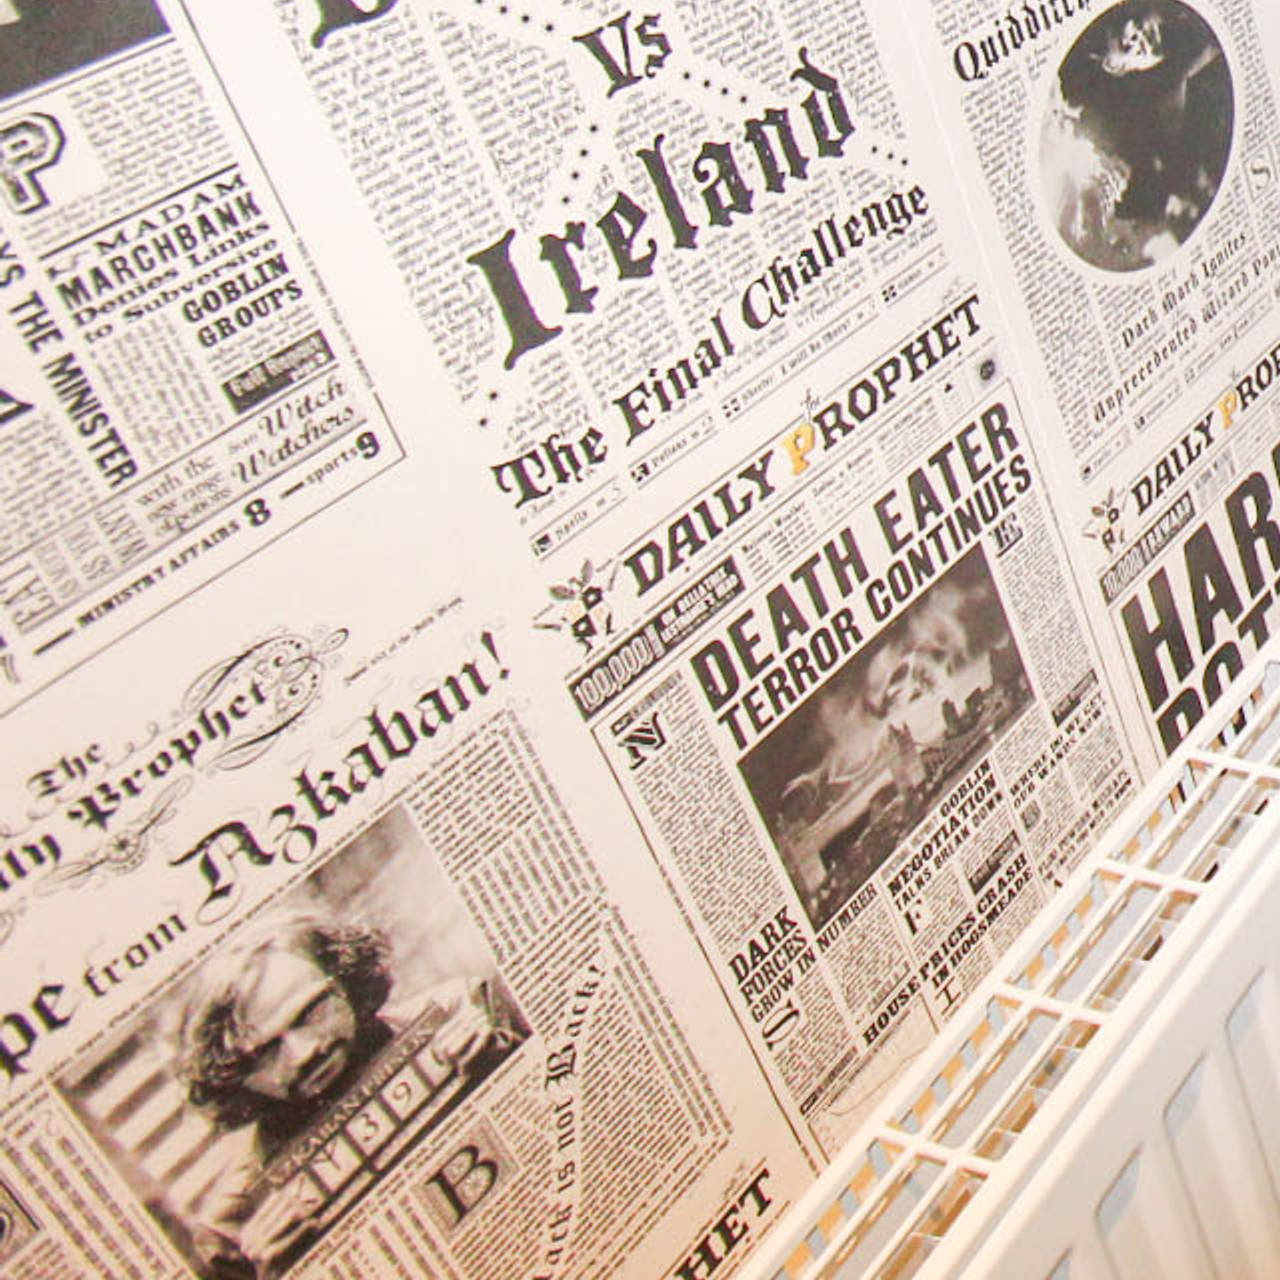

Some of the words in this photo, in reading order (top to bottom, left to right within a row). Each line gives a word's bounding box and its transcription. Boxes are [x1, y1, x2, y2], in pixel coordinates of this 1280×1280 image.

[56, 190, 264, 312] MARCHBANK
[95, 172, 248, 257] MADAM
[466, 45, 856, 372] Ireland
[72, 266, 181, 328] Denies
[188, 221, 271, 269] Links
[84, 322, 114, 346] to
[123, 237, 279, 324] Subversive
[181, 252, 290, 324] GOBLIN
[197, 279, 304, 349] GROUPS
[1120, 306, 1160, 350] Dark
[1161, 272, 1201, 315] Mark
[8, 290, 65, 355] THE
[42, 352, 139, 490] MINISTER
[490, 425, 608, 509] The
[612, 309, 736, 448] Final
[740, 183, 930, 332] Challenge
[1092, 318, 1199, 424] Unprecedented
[1201, 276, 1250, 325] Wizard
[624, 449, 777, 598] DAILY
[781, 292, 982, 478] PROPHET
[1129, 411, 1222, 518] DAILY
[76, 566, 167, 628] MINISTRY
[168, 519, 243, 573] AFFAIRS
[243, 497, 272, 528] 8
[306, 447, 360, 486] sports
[355, 431, 382, 461] 9
[689, 527, 871, 714] DEATH
[872, 401, 1020, 556] EATER
[716, 605, 865, 752] TERROR
[864, 453, 1033, 624] CONTINUES
[26, 741, 103, 799] The
[67, 676, 269, 832] Prophet
[82, 912, 189, 999] from
[168, 627, 512, 926] Azkaban!
[938, 758, 993, 819] GOBLIN
[886, 773, 999, 899] NEGOTIATION
[727, 904, 799, 986] DARK
[738, 928, 809, 1008] FORCES
[749, 970, 795, 1024] GROW
[796, 945, 818, 976] IN
[814, 881, 879, 955] NUMBER
[861, 975, 923, 1047] HOUSE
[919, 911, 977, 982] PRICES
[975, 852, 1029, 915] CRASH
